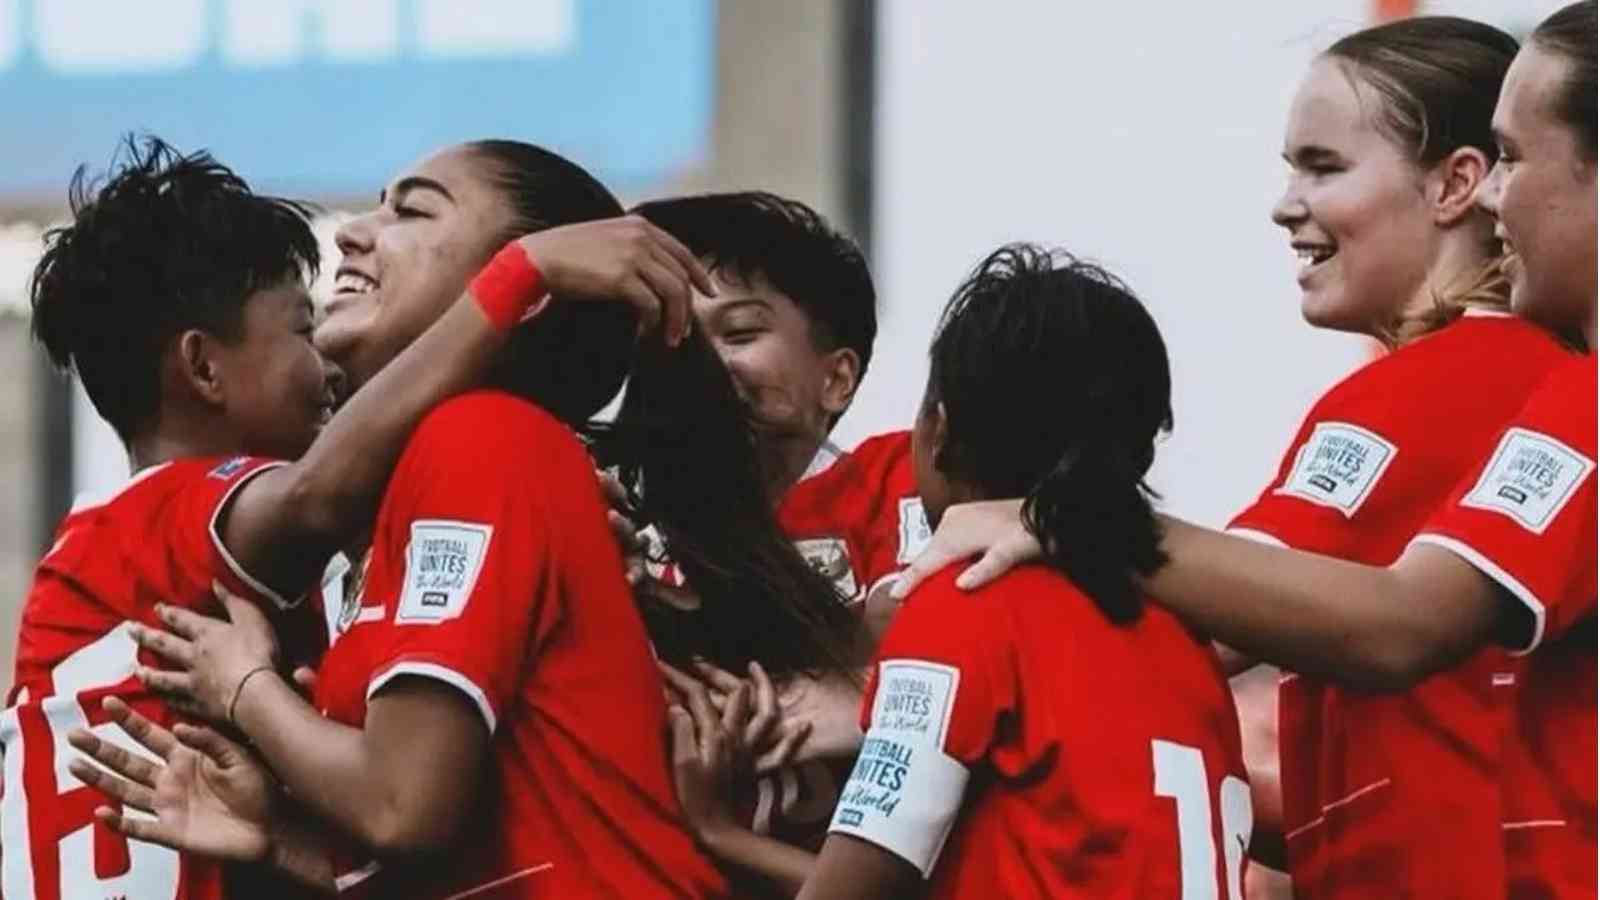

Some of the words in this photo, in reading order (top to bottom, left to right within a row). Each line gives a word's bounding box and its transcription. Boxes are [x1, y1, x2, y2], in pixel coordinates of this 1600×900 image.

[1315, 446, 1366, 473] UNITES
[1506, 460, 1556, 488] UNITES
[419, 554, 467, 574] UNITES
[883, 693, 931, 716] UNITES
[855, 758, 907, 792] NITES
